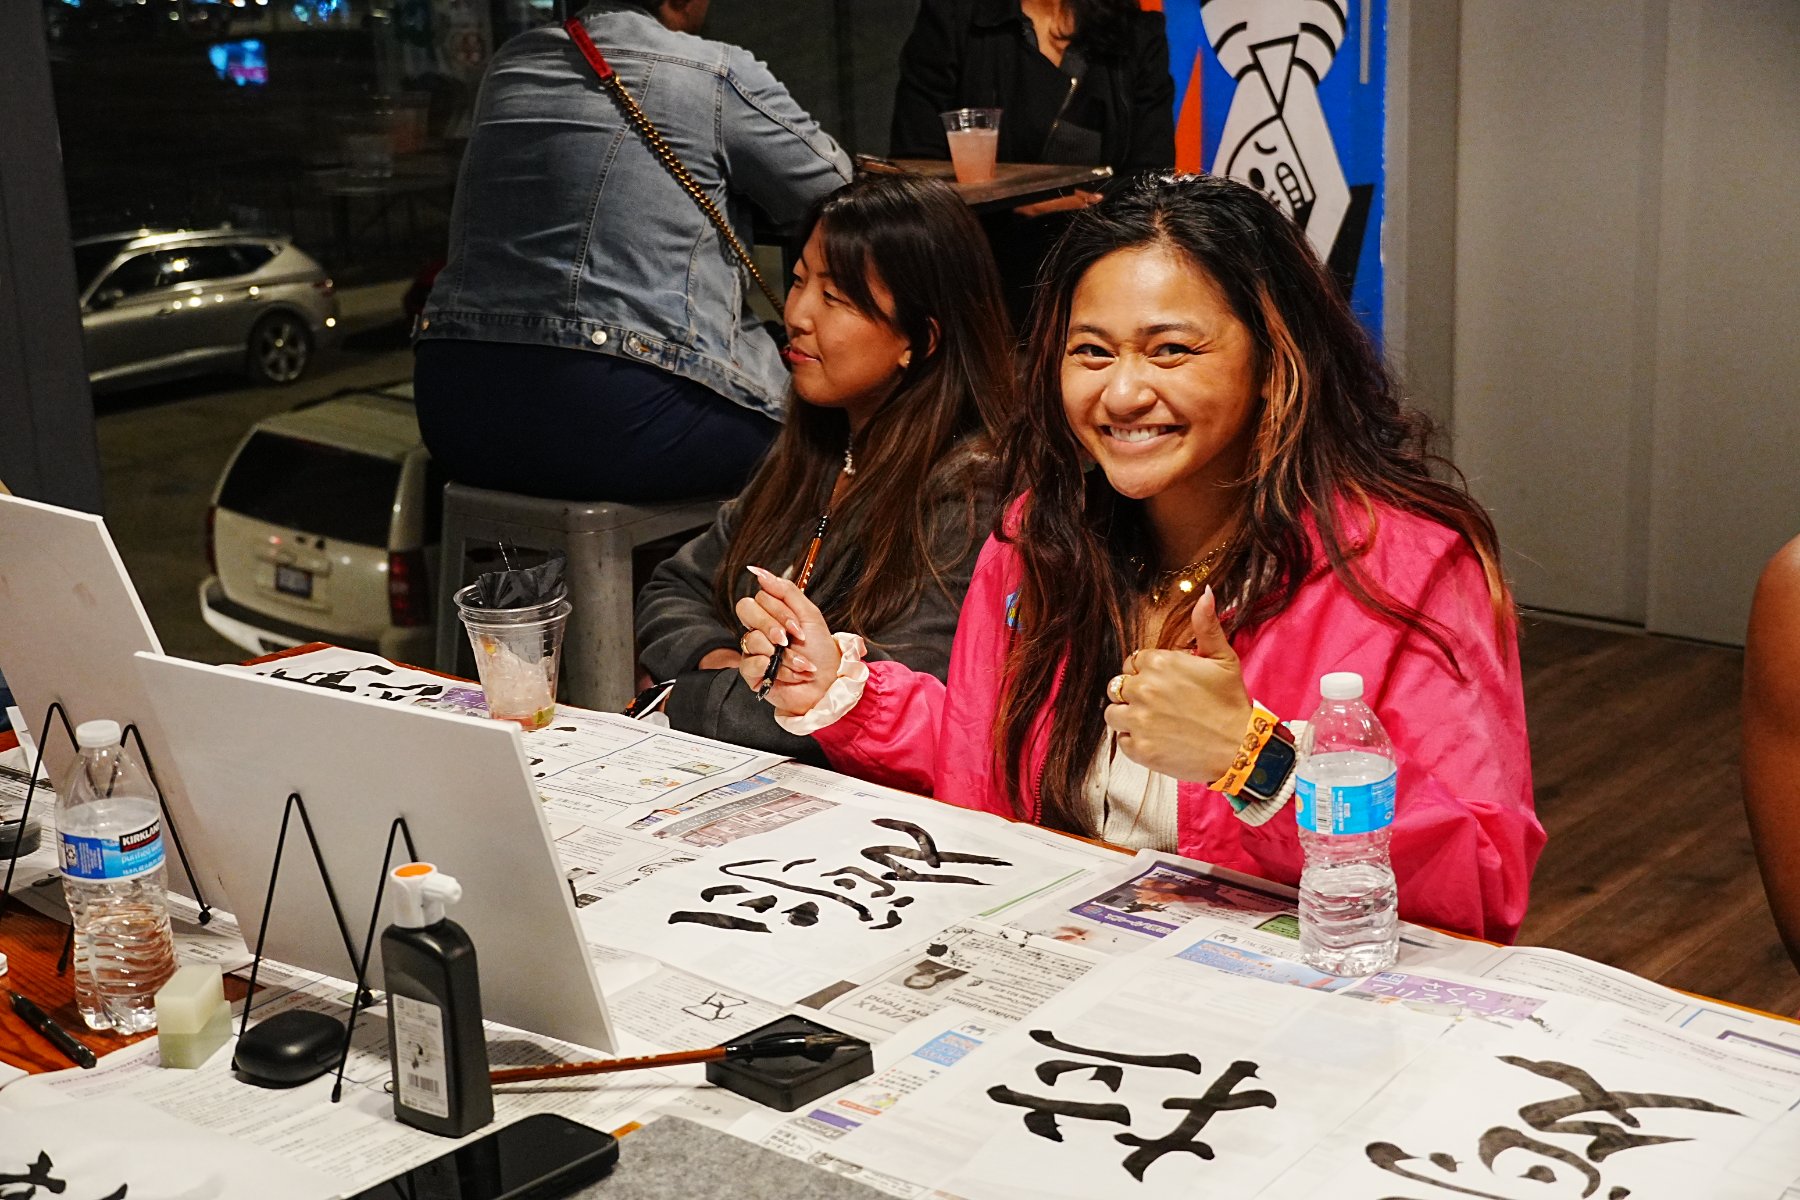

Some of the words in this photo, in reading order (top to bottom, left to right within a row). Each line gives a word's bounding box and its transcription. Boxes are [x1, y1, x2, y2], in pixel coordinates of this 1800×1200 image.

[1422, 981, 1488, 1001] さくら
[864, 994, 904, 1013] Trend
[944, 995, 987, 1013] Fujimori
